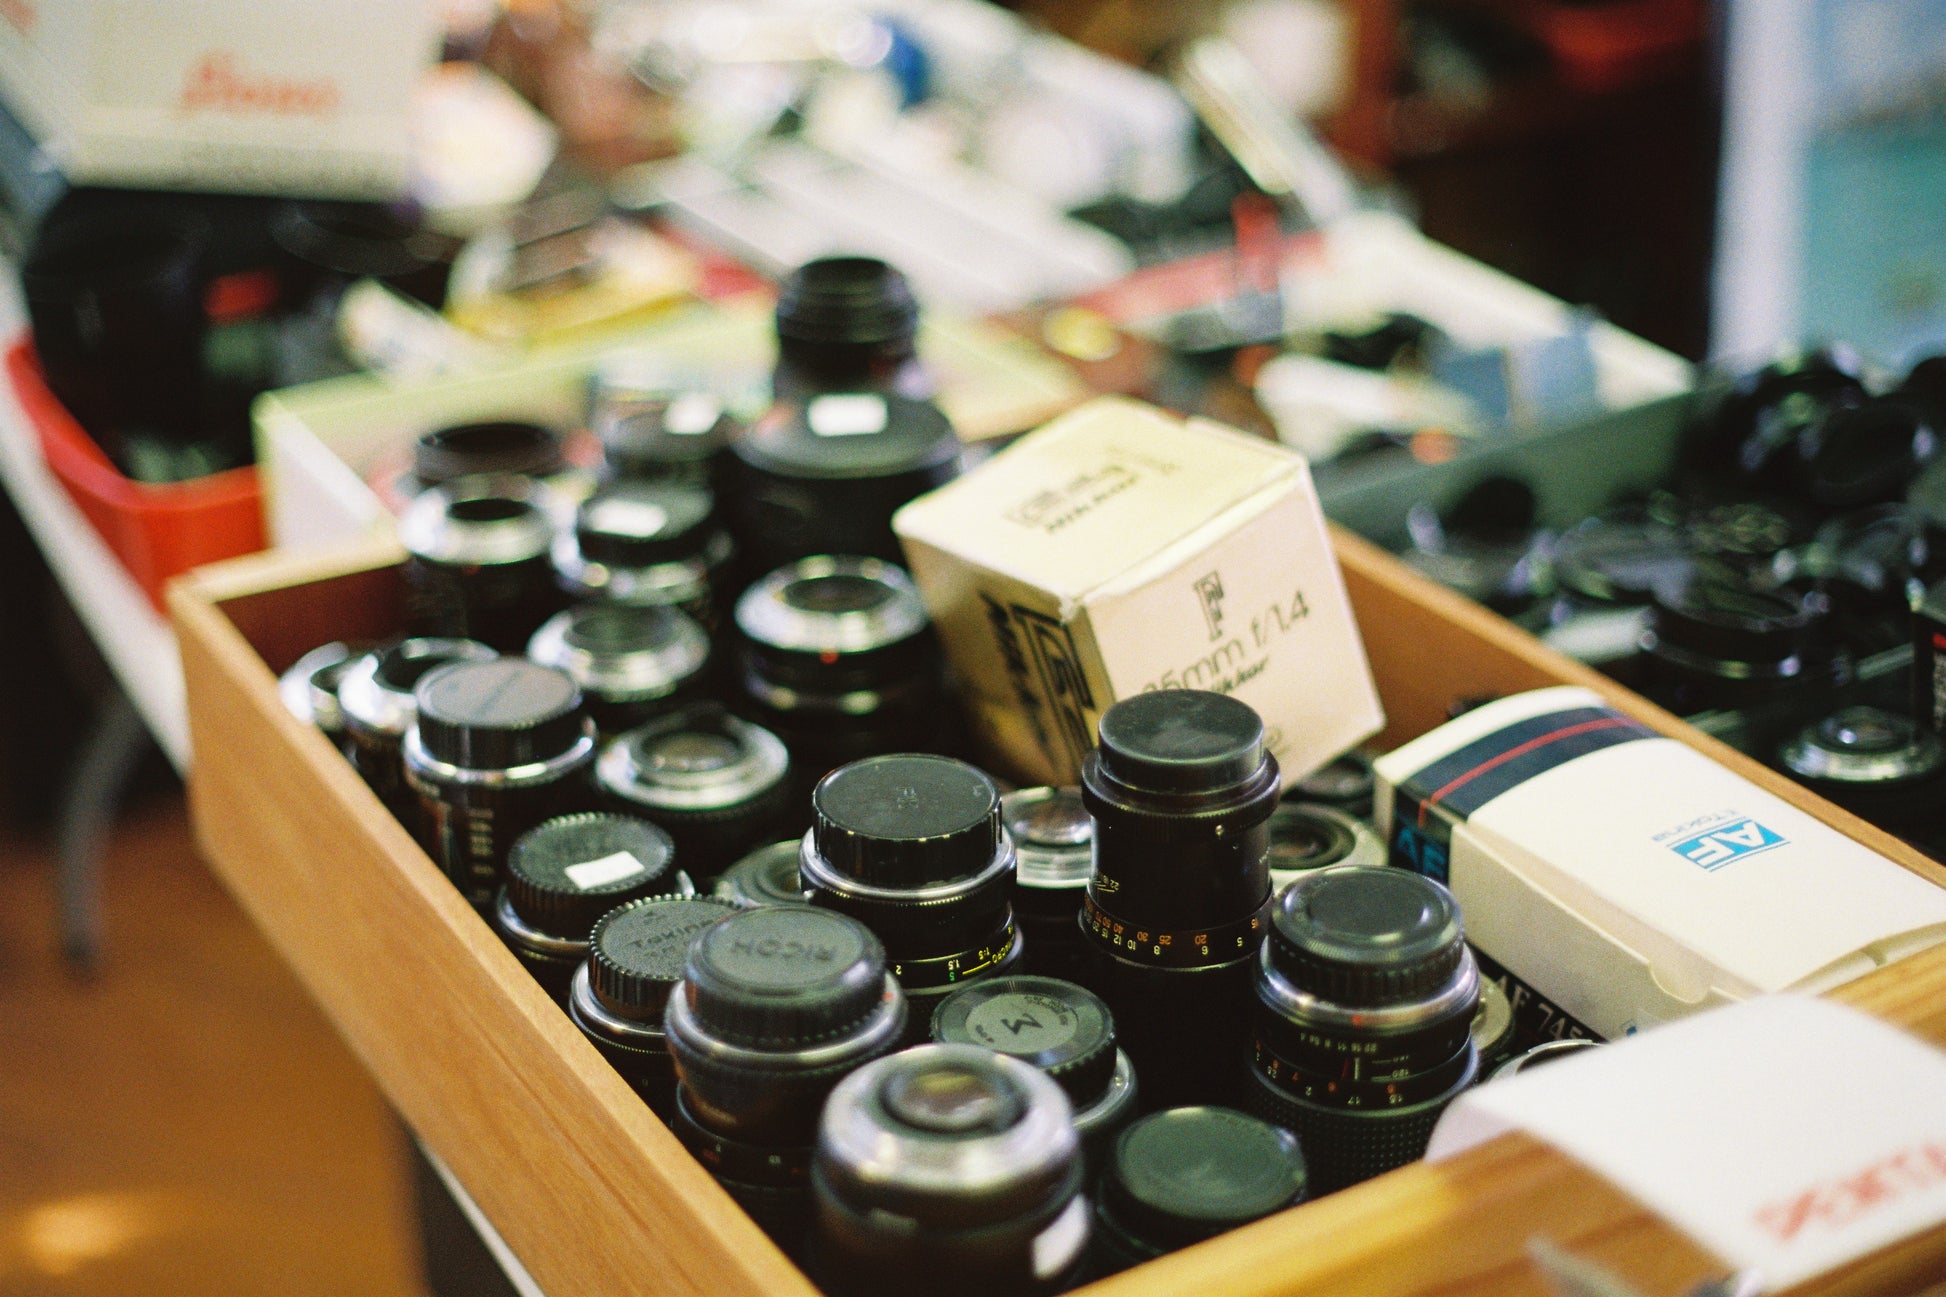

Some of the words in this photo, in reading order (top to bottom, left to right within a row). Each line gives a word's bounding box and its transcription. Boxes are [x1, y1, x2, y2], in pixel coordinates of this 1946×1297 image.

[1680, 820, 1775, 868] AF
[1113, 934, 1122, 946] 12
[1136, 931, 1149, 942] 30
[1159, 935, 1172, 945] 25
[1194, 934, 1207, 945] 20
[1127, 939, 1136, 951] 10
[1153, 945, 1161, 956] 8
[1201, 945, 1209, 956] 6
[895, 964, 902, 975] 2
